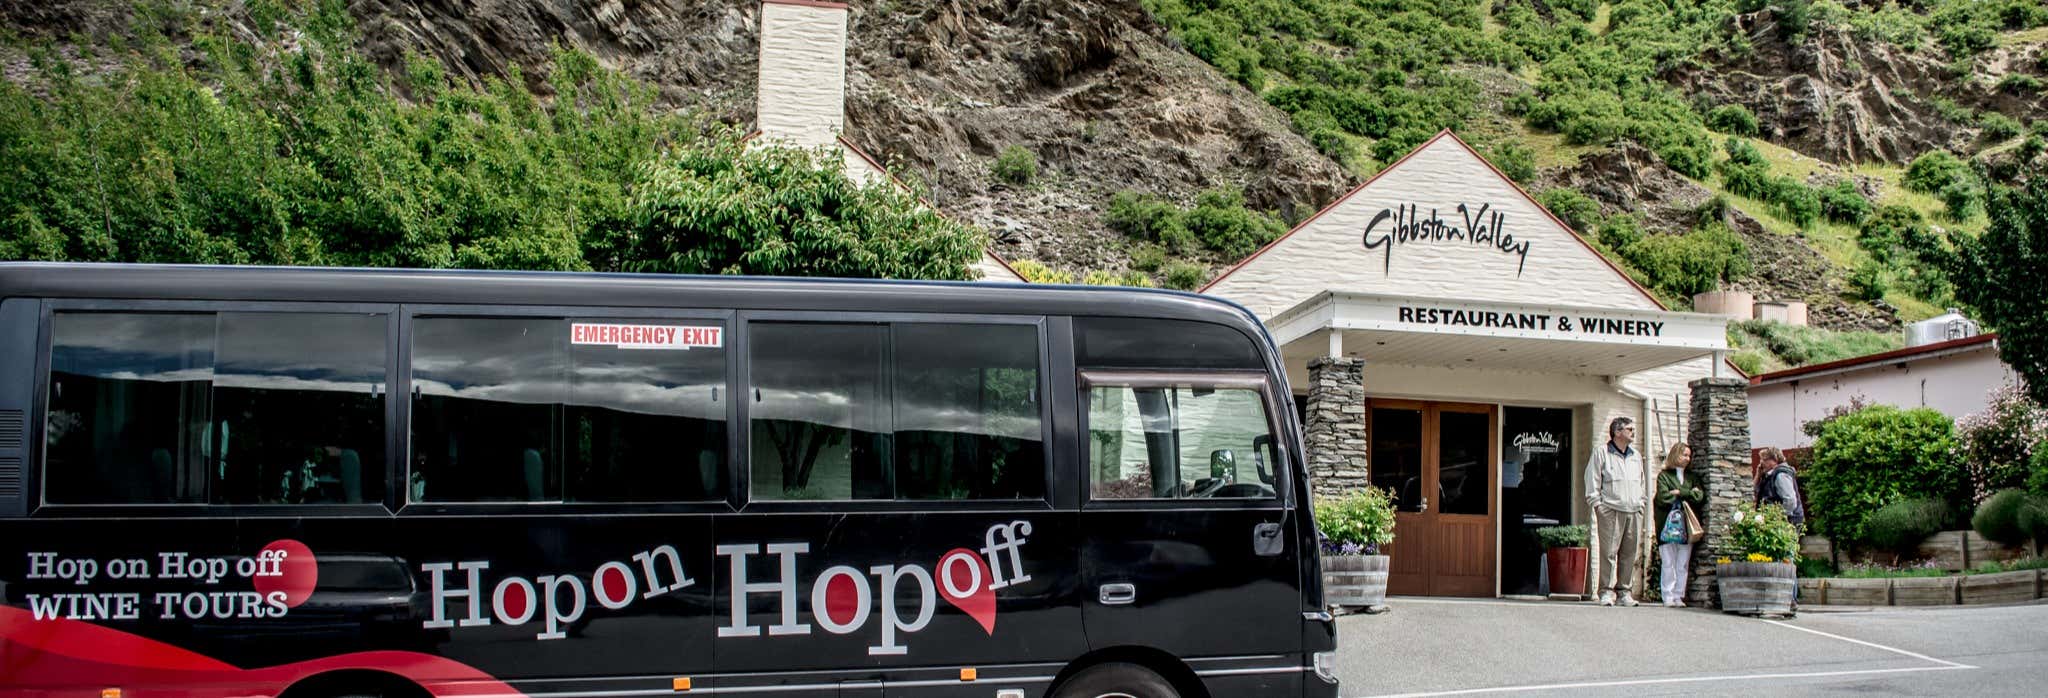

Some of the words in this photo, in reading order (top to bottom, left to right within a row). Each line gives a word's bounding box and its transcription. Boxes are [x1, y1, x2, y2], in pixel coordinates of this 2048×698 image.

[1363, 201, 1465, 278] Gibbston
[1457, 202, 1530, 279] Valley
[574, 325, 677, 344] EMERGENCY
[683, 327, 720, 346] EXIT
[1398, 306, 1551, 331] RESTAURANT
[1557, 315, 1573, 332] &
[1579, 316, 1665, 337] WINERY
[1538, 431, 1560, 453] Valley
[26, 552, 98, 585] Hop
[106, 558, 150, 579] on
[158, 552, 228, 584] Hop
[236, 550, 288, 577] off
[421, 560, 587, 640] Hop
[716, 542, 937, 655] Hop
[941, 520, 1033, 600] off
[26, 593, 140, 621] WINE
[155, 591, 289, 620] TOURS
